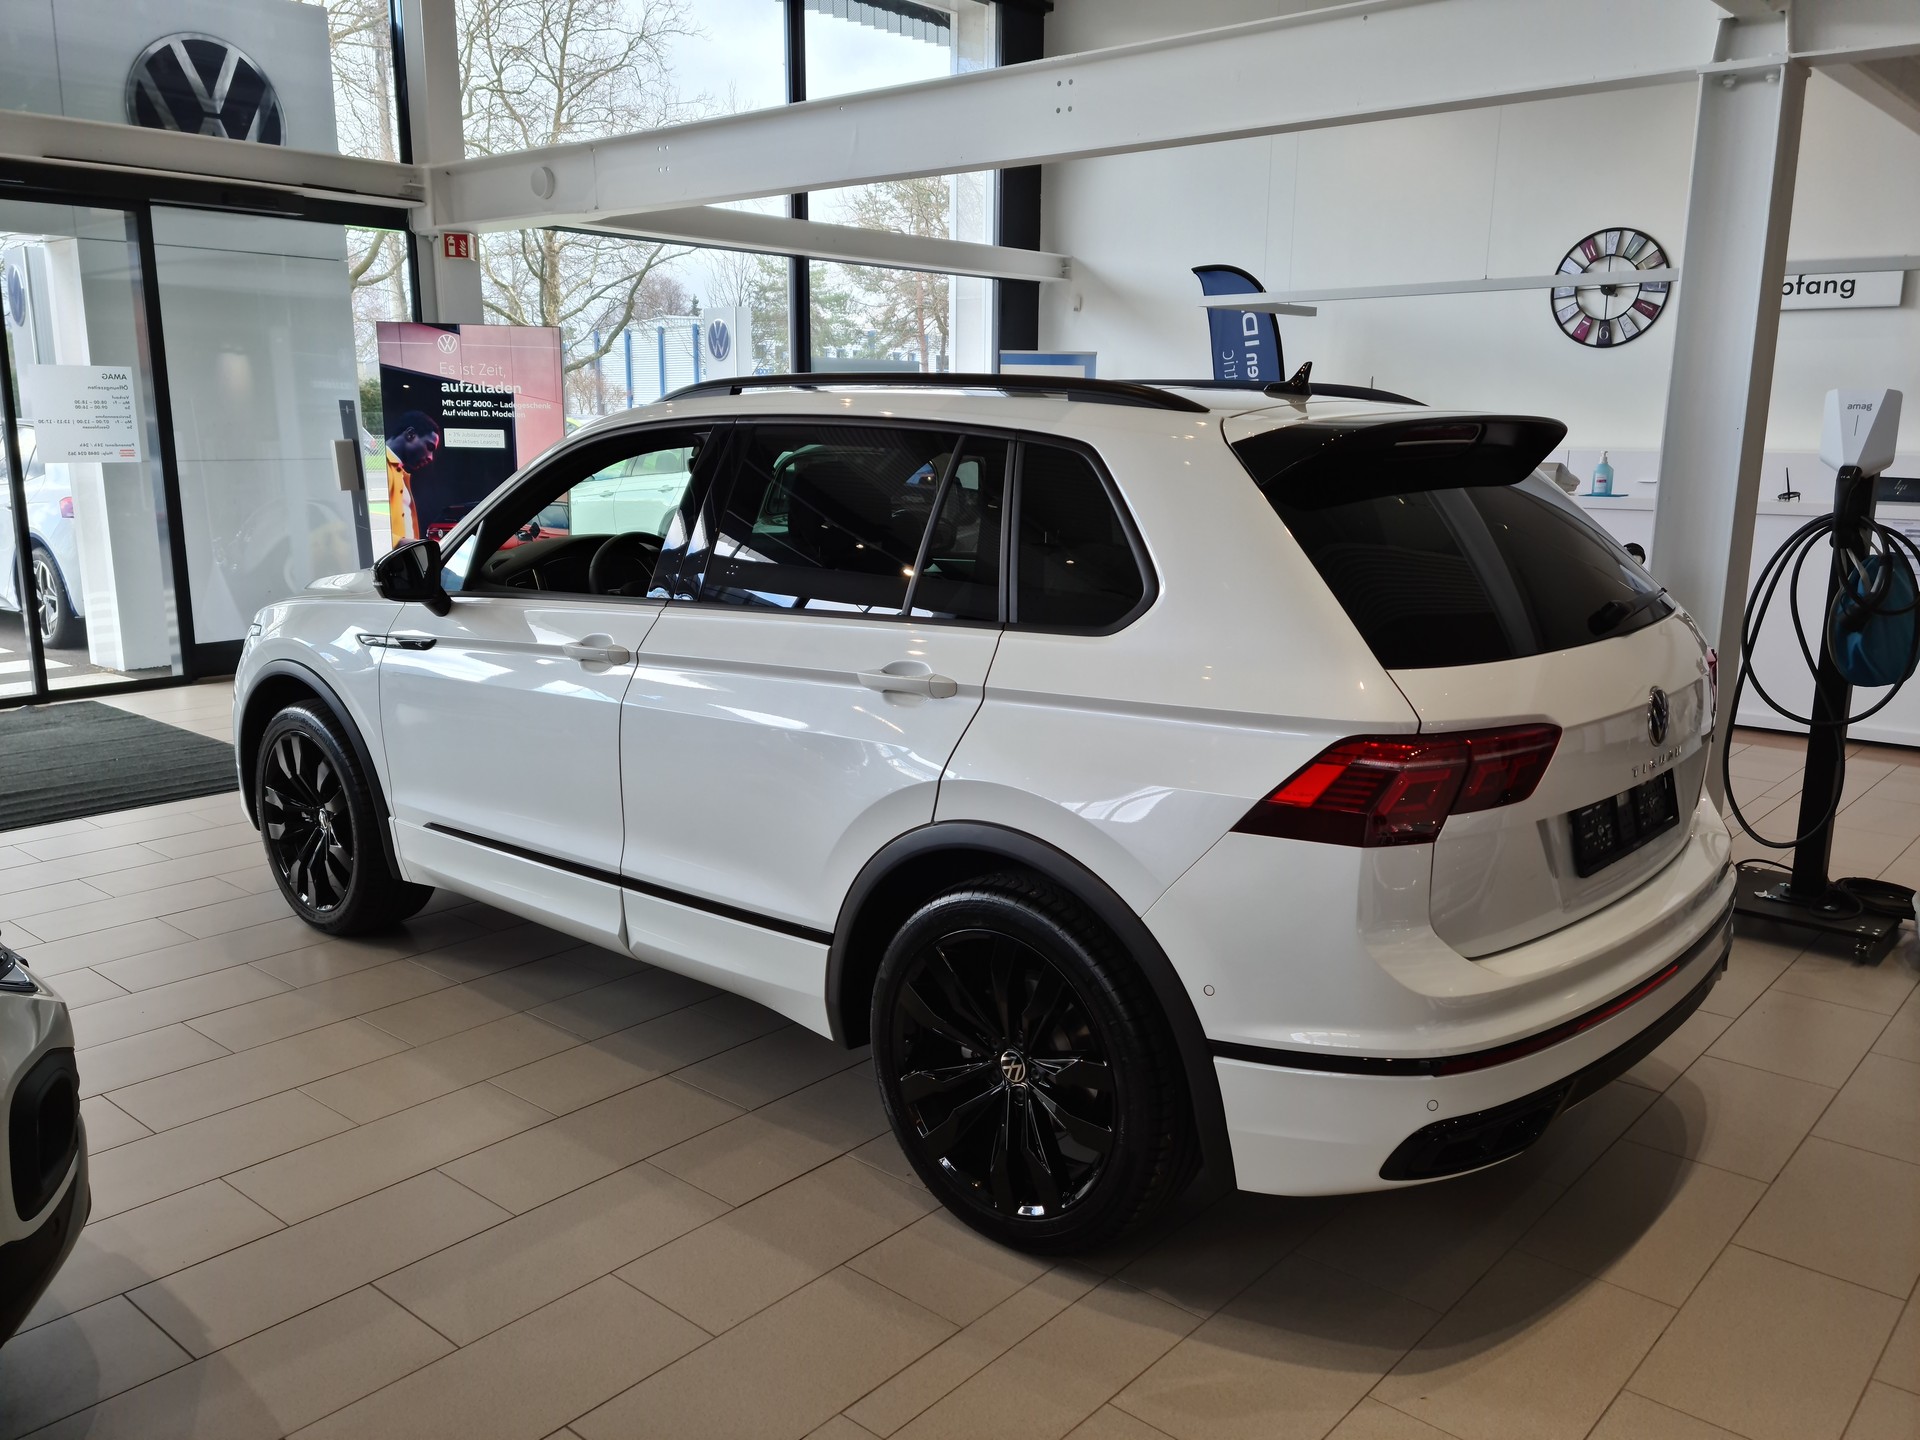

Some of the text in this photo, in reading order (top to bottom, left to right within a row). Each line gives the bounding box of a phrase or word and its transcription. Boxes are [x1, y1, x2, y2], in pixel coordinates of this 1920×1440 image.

[1599, 326, 1609, 340] 6
[439, 362, 455, 375] Es
[459, 362, 474, 376] ist
[441, 380, 521, 394] aufzuladen
[441, 399, 455, 407] Mit
[455, 400, 471, 408] CHF
[499, 401, 551, 410] Ladegeschenk
[1846, 402, 1873, 412] amag
[442, 409, 455, 417] Auf
[456, 409, 479, 417] vielen
[480, 410, 491, 418] ID.
